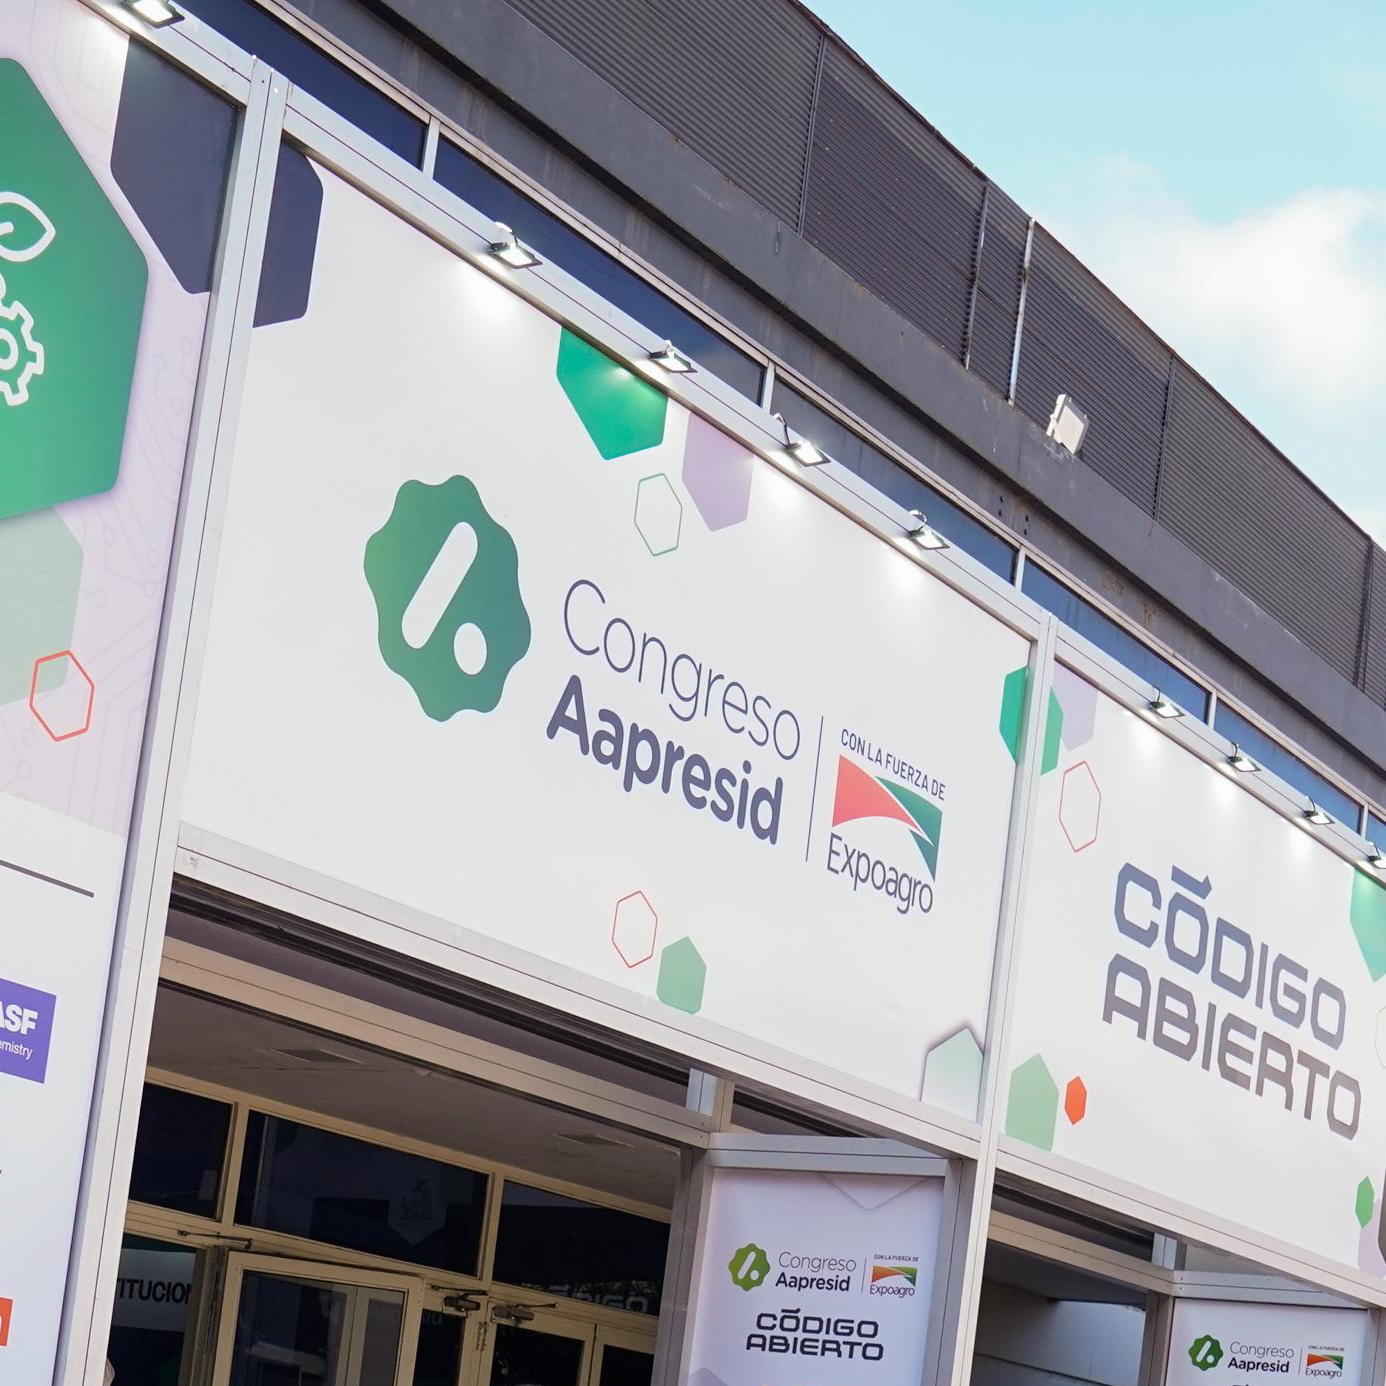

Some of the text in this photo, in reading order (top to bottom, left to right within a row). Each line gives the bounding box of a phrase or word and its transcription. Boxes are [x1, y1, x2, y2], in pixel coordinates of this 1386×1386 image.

[563, 579, 800, 760] Congreso
[546, 674, 783, 845] Aapresid
[840, 728, 946, 801] CON LA FUERZA DE
[827, 832, 935, 914] Expoagro
[1114, 862, 1347, 1050] CÓDIGO
[1102, 953, 1361, 1141] ABIERTO
[778, 1251, 857, 1272] Congreso
[775, 1272, 851, 1292] Aapresid
[870, 1284, 915, 1298] Expoagro
[756, 1307, 879, 1338] CÓDIGO
[746, 1333, 884, 1361] ABIERTO
[1230, 1341, 1294, 1359] Congreso
[1228, 1357, 1289, 1373] Aapresid
[1305, 1368, 1343, 1379] Expoagro
